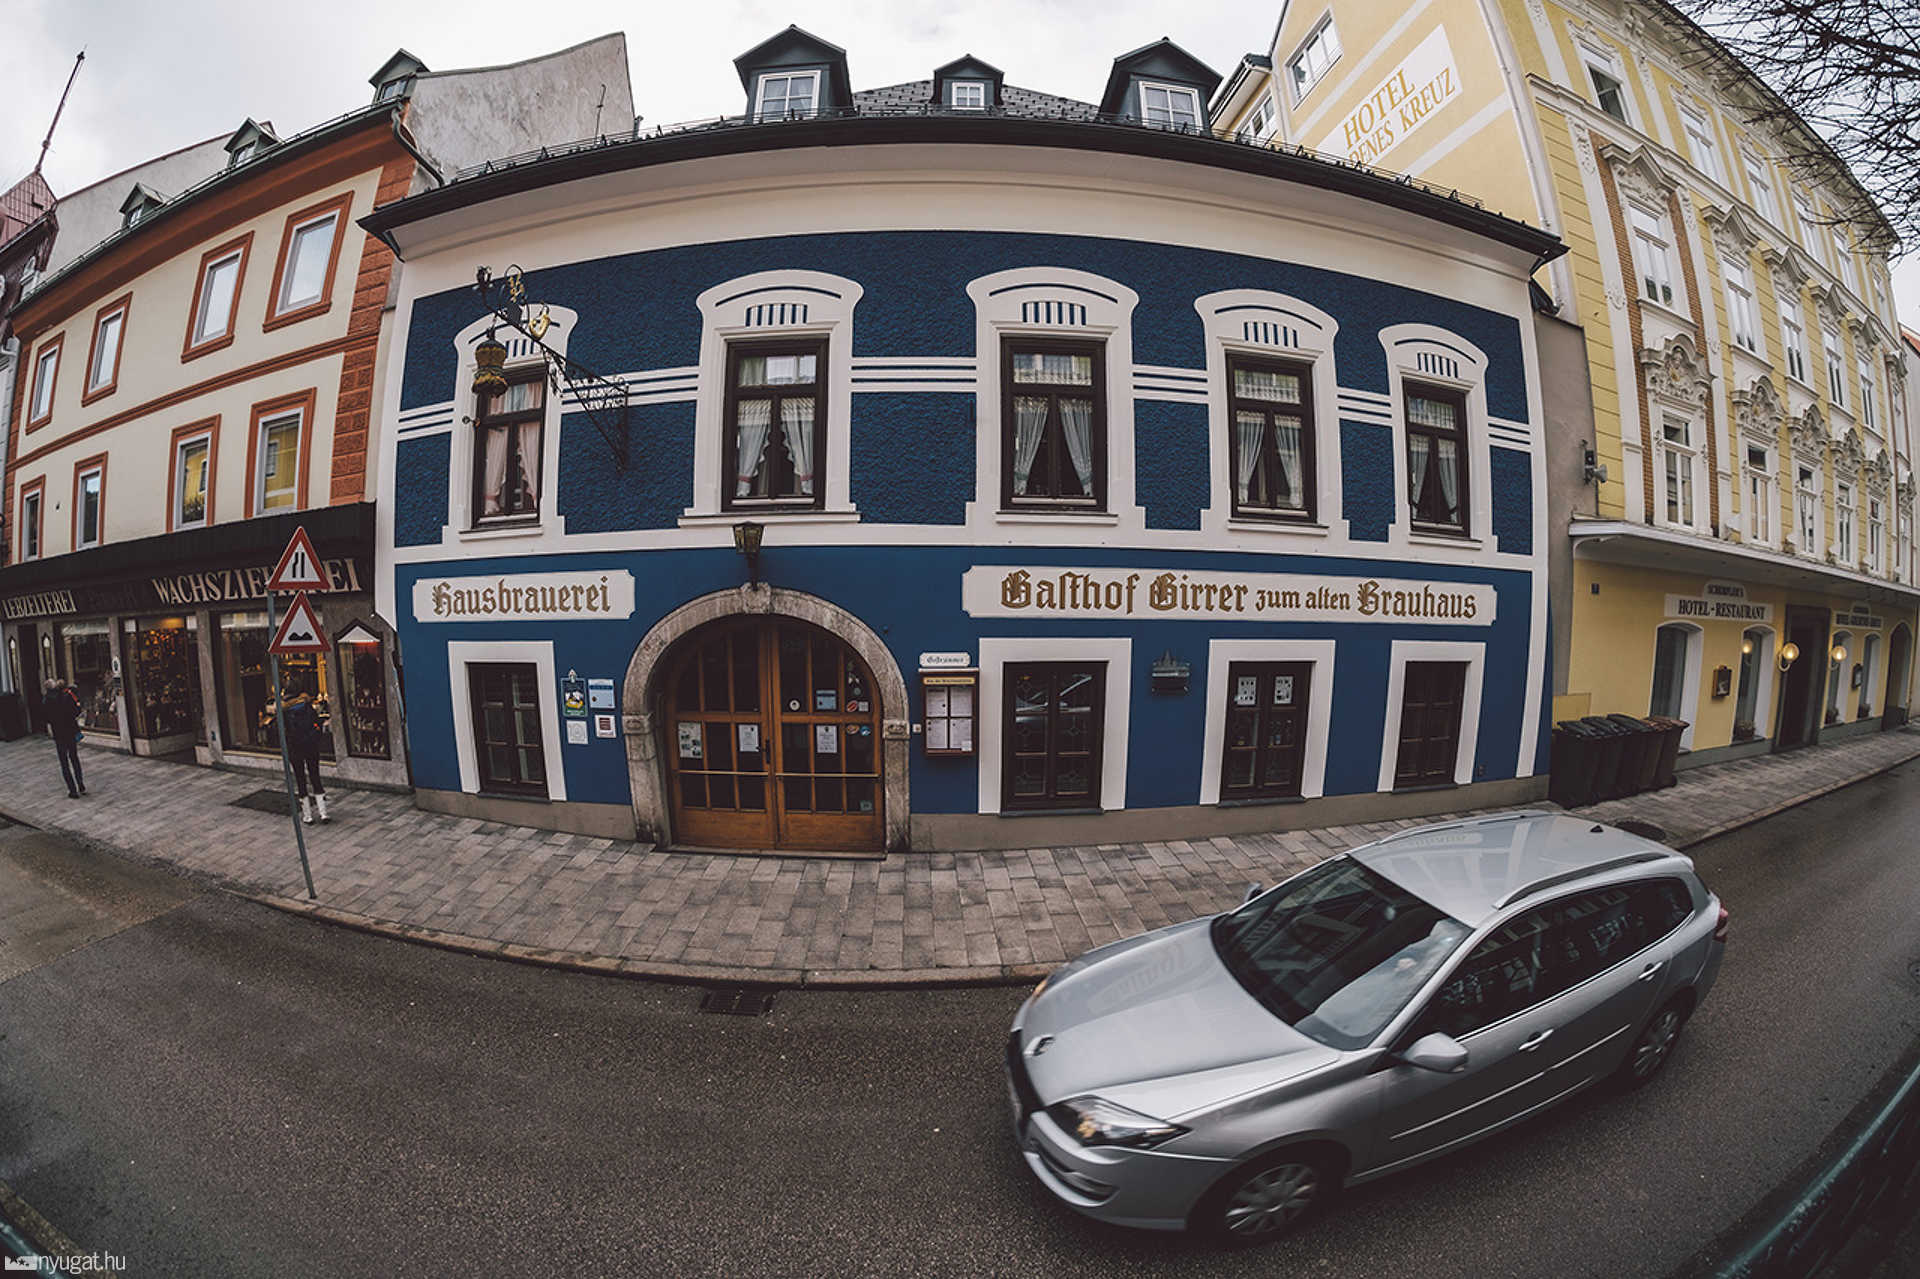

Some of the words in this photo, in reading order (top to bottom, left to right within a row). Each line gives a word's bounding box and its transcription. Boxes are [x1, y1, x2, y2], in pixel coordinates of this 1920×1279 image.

[1343, 69, 1415, 150] HOTEL
[1399, 67, 1455, 133] KREUZ
[152, 558, 362, 605] WACHSZIEEI
[432, 575, 611, 618] Hausbrauerei
[1256, 588, 1300, 611] zum
[1305, 585, 1350, 610] alten
[1357, 580, 1476, 619] Brauhaus
